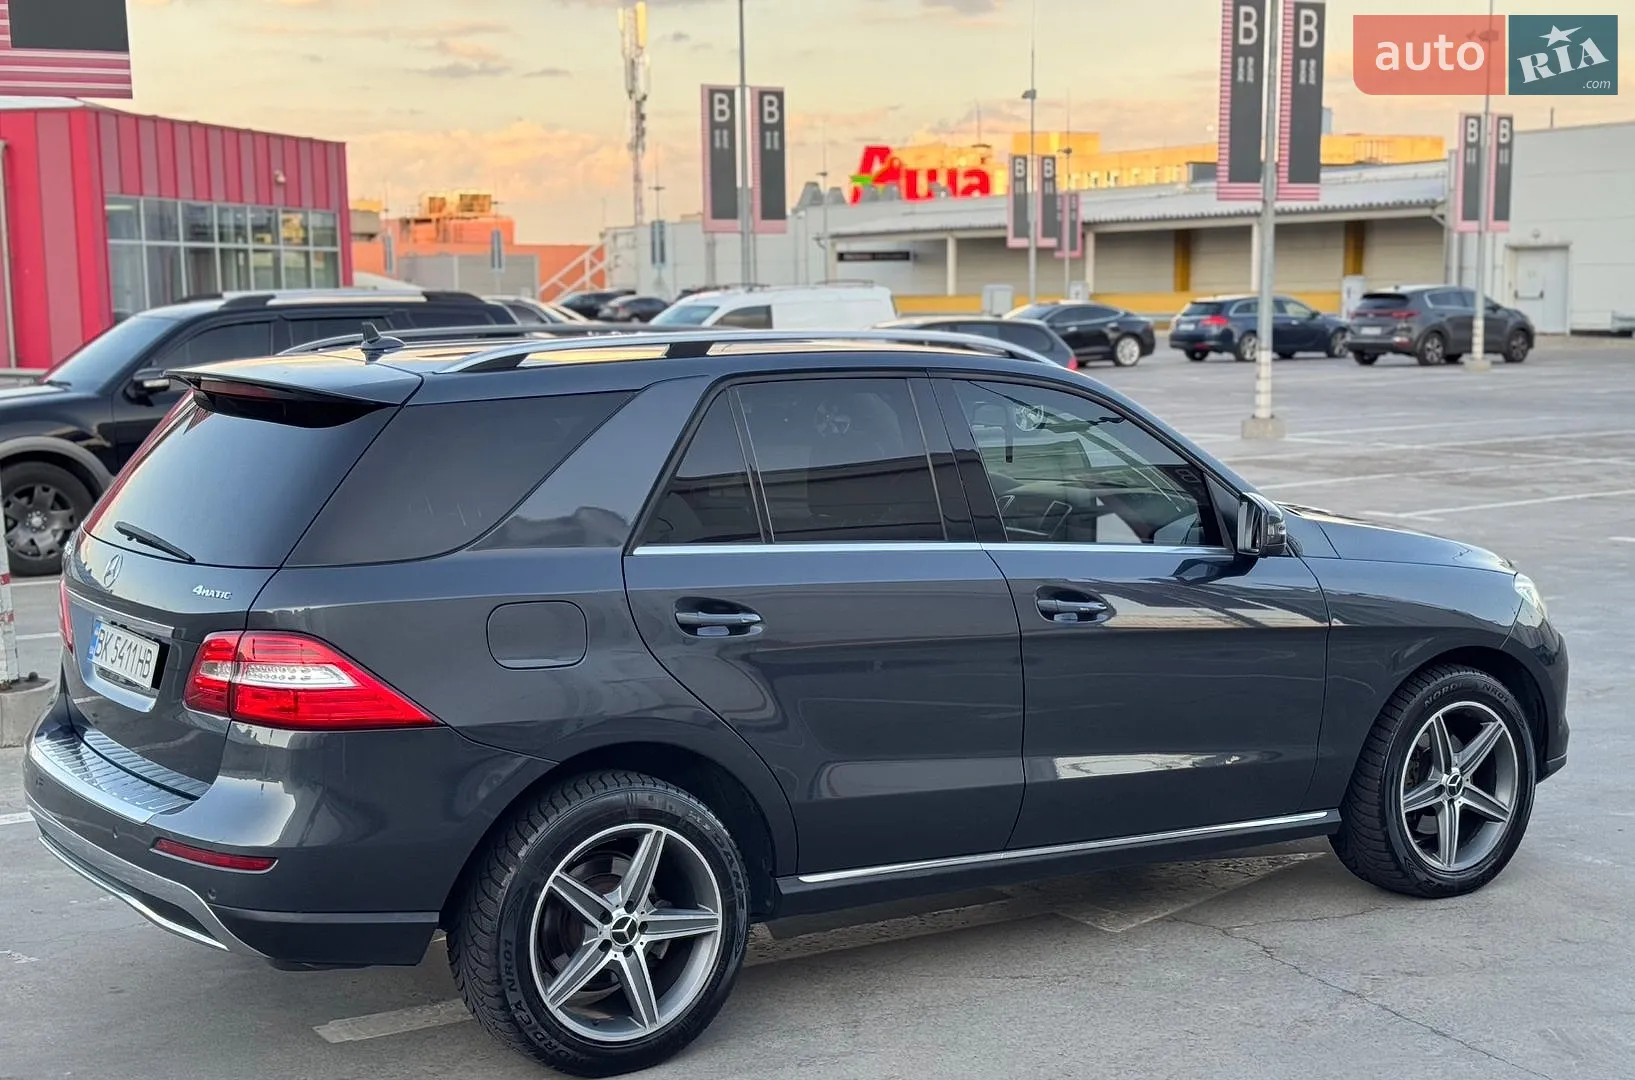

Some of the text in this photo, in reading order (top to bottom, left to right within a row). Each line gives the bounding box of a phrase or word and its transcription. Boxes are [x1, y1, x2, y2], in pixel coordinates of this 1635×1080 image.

[1238, 5, 1258, 45] B
[1299, 8, 1318, 48] B
[713, 92, 730, 122] B
[762, 95, 780, 124] B
[1467, 118, 1478, 142] B
[1499, 119, 1510, 143] B
[192, 584, 232, 599] 4MATIC
[94, 629, 153, 678] BK 5411 HB
